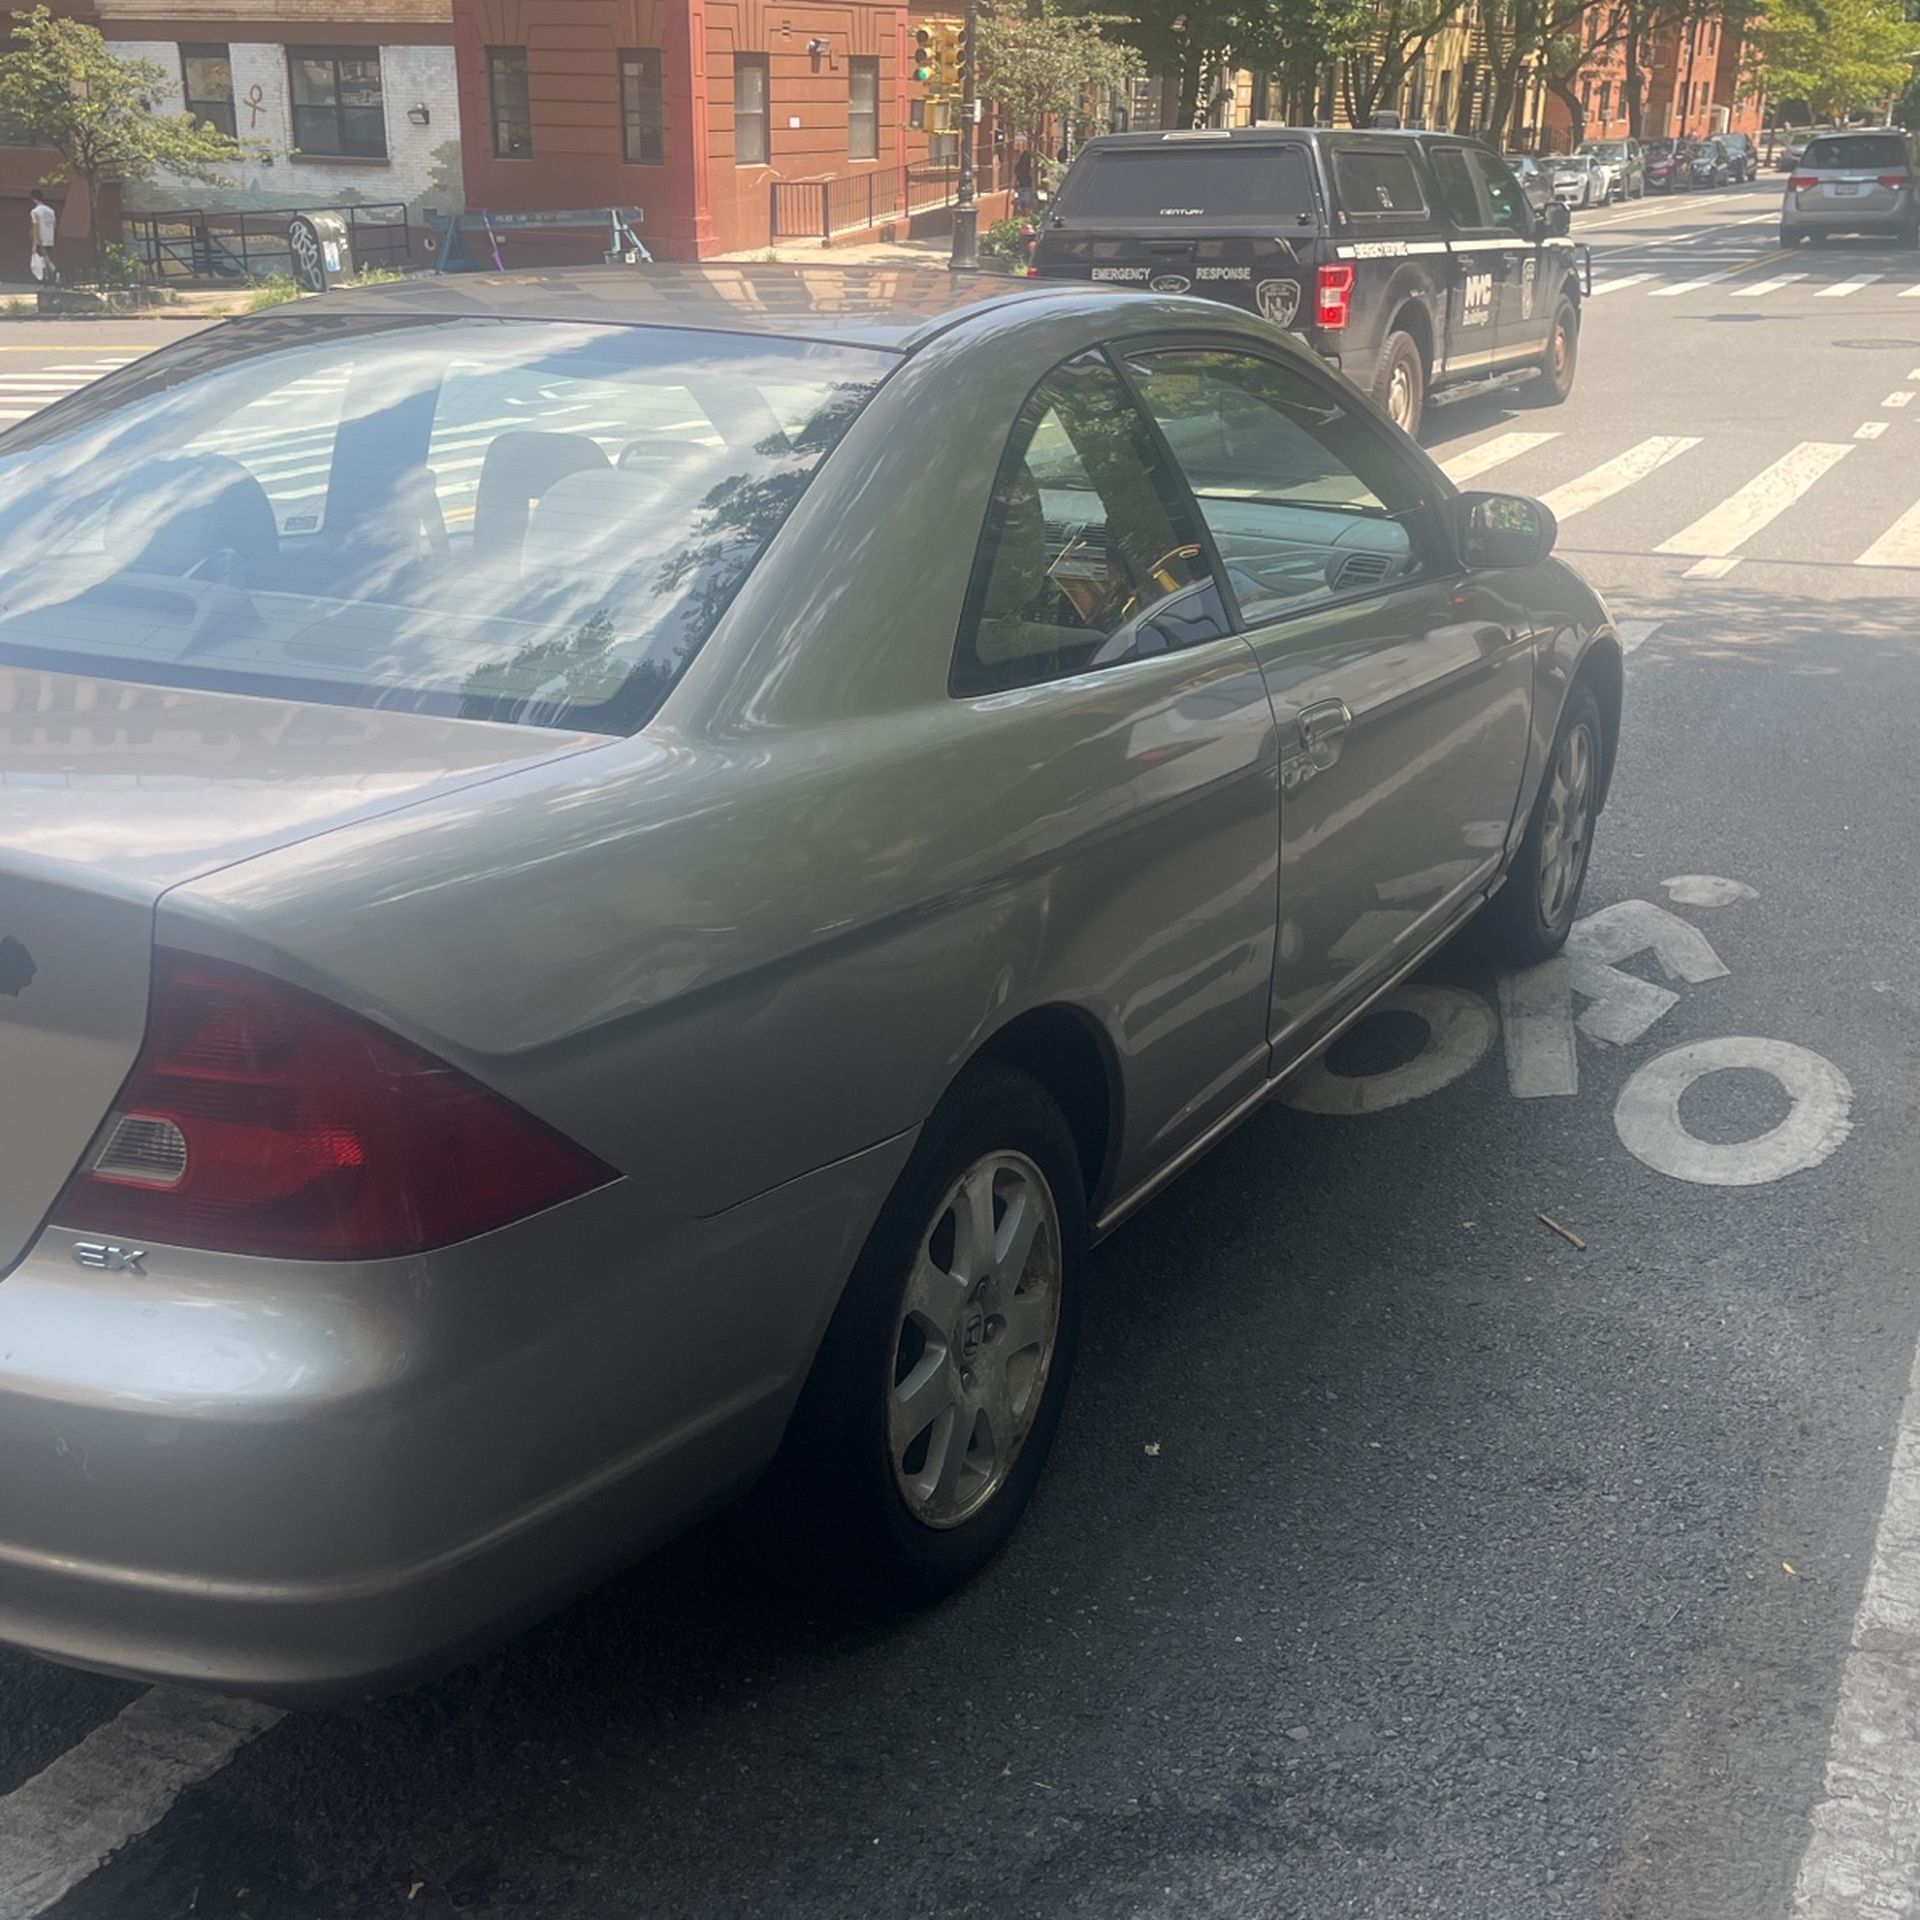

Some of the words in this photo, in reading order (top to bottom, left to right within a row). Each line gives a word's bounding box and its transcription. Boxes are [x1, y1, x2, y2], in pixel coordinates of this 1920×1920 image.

[1160, 208, 1204, 216] CENTURY
[1091, 267, 1151, 281] EMERGENCY
[1196, 266, 1252, 280] RESPONSE
[1158, 279, 1182, 291] Ford
[1465, 273, 1492, 308] NYC
[72, 1241, 149, 1277] EX
